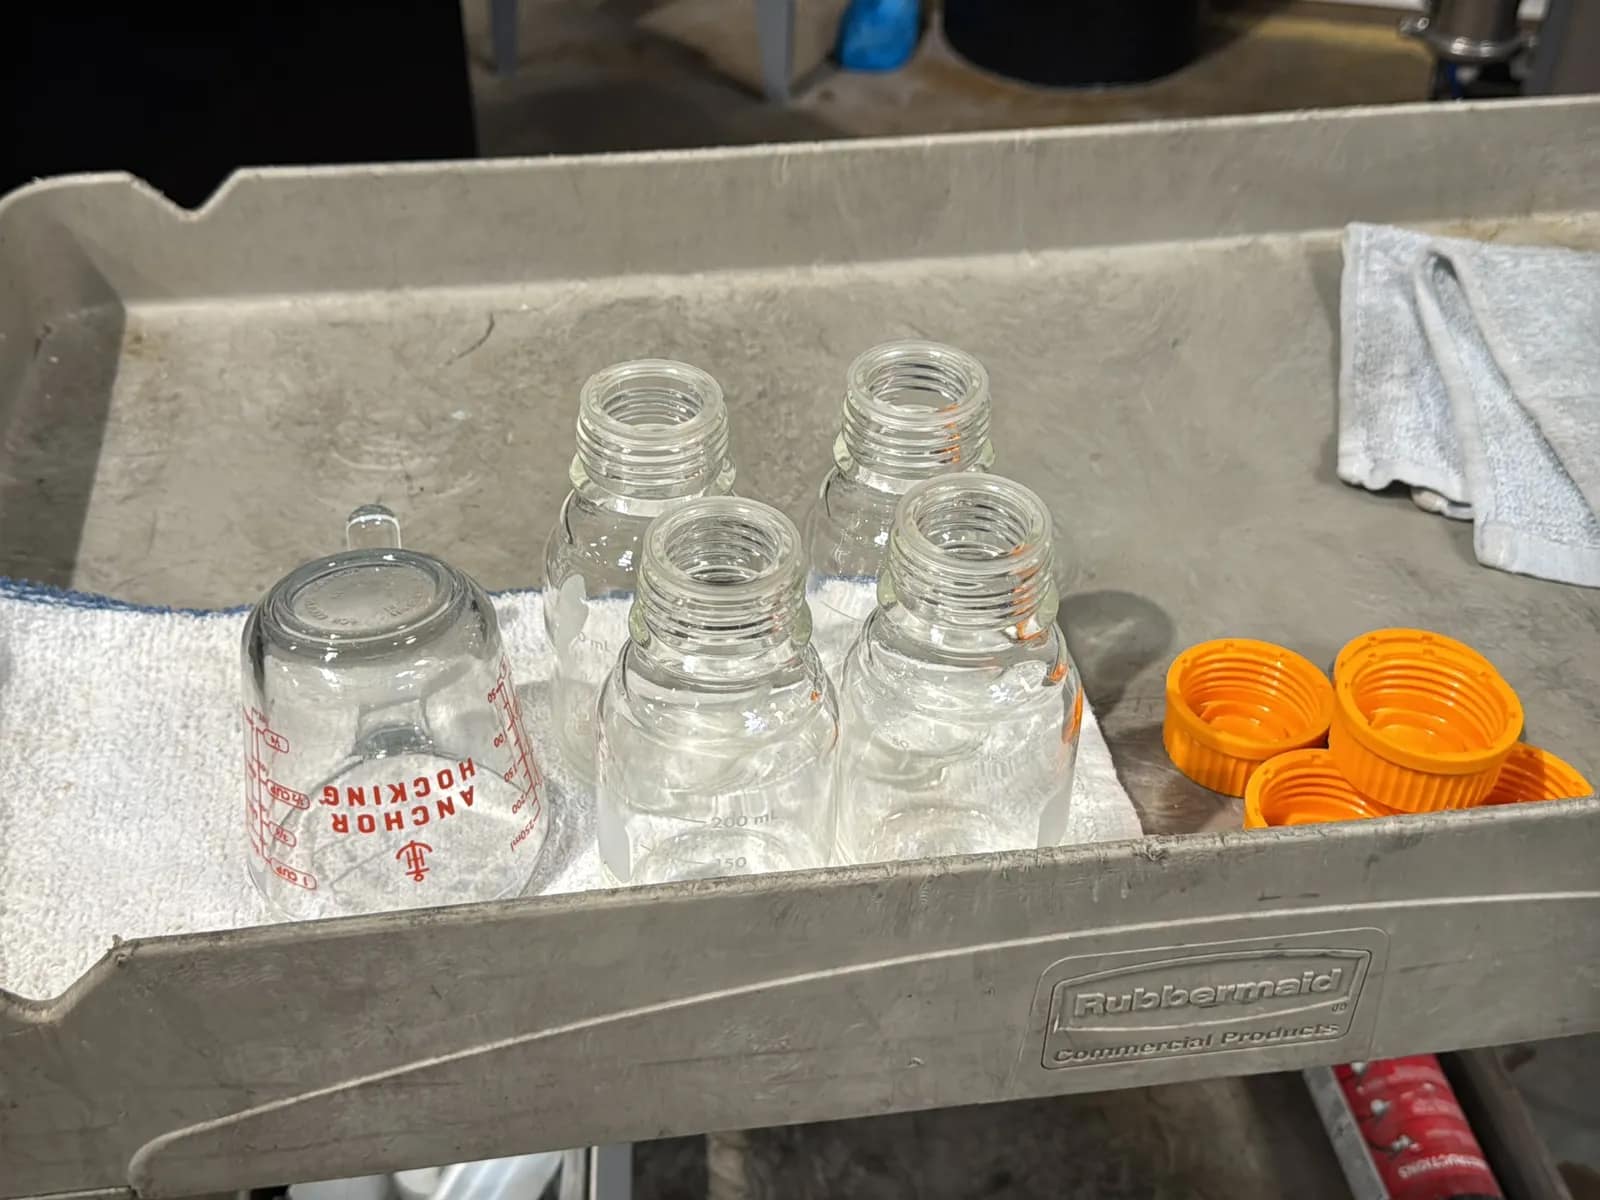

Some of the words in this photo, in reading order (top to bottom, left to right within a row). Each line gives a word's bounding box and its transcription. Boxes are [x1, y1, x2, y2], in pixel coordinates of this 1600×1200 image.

[322, 757, 476, 807] HOCKING
[504, 762, 519, 783] 150
[271, 785, 291, 801] CUP
[331, 785, 475, 834] ANCHOR
[711, 815, 749, 830] 200
[276, 866, 298, 882] CUP
[1073, 967, 1342, 1018] Rubbermaid
[1052, 1033, 1213, 1064] Commercial
[1220, 1021, 1341, 1048] Products
